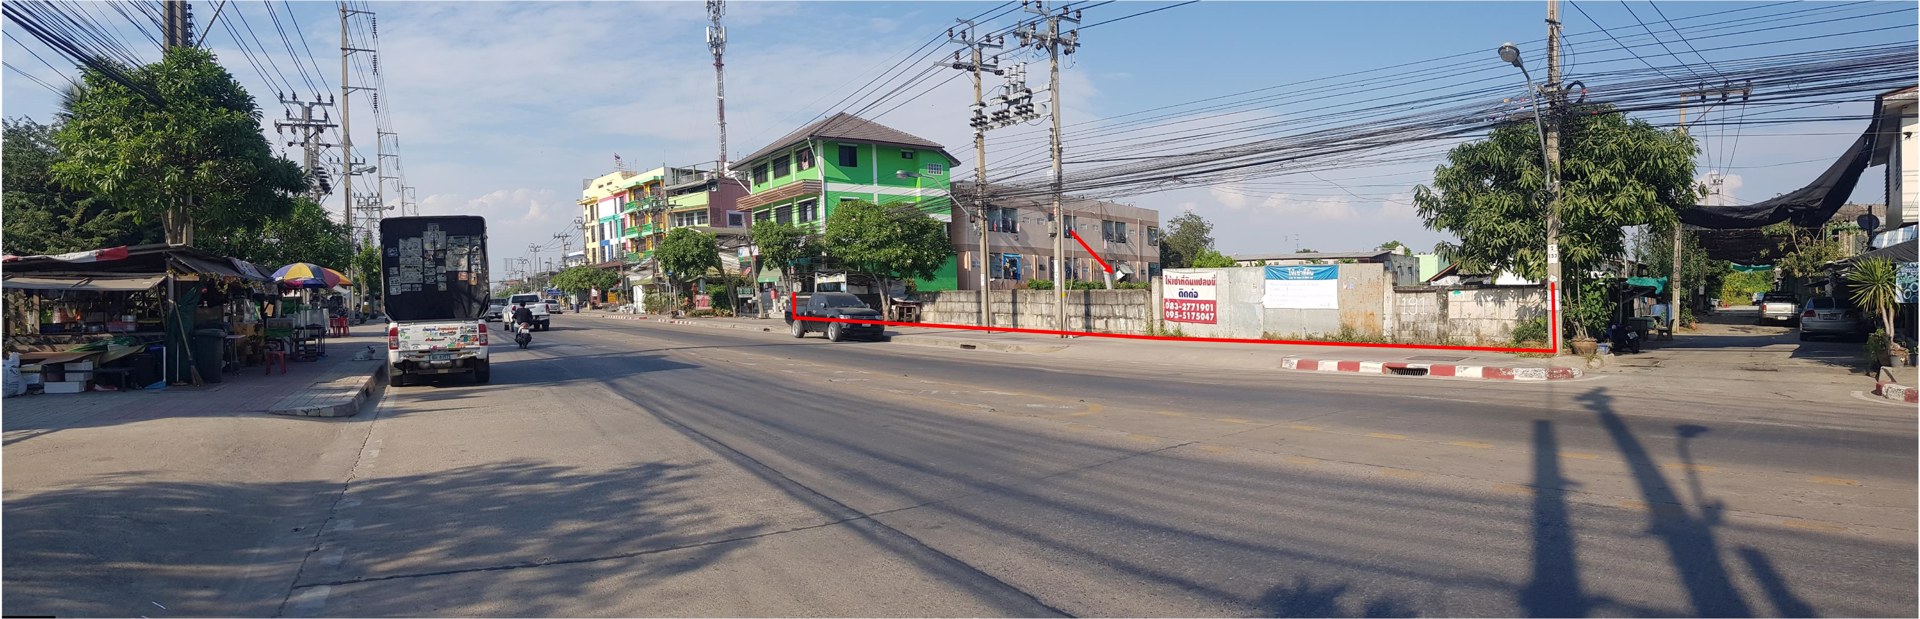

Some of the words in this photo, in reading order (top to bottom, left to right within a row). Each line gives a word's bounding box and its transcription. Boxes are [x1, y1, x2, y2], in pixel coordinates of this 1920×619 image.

[1178, 288, 1199, 298] ติดต่อ
[1165, 301, 1214, 311] 083-2771901
[1401, 296, 1427, 315] 191
[1165, 310, 1215, 321] 095-5175047
